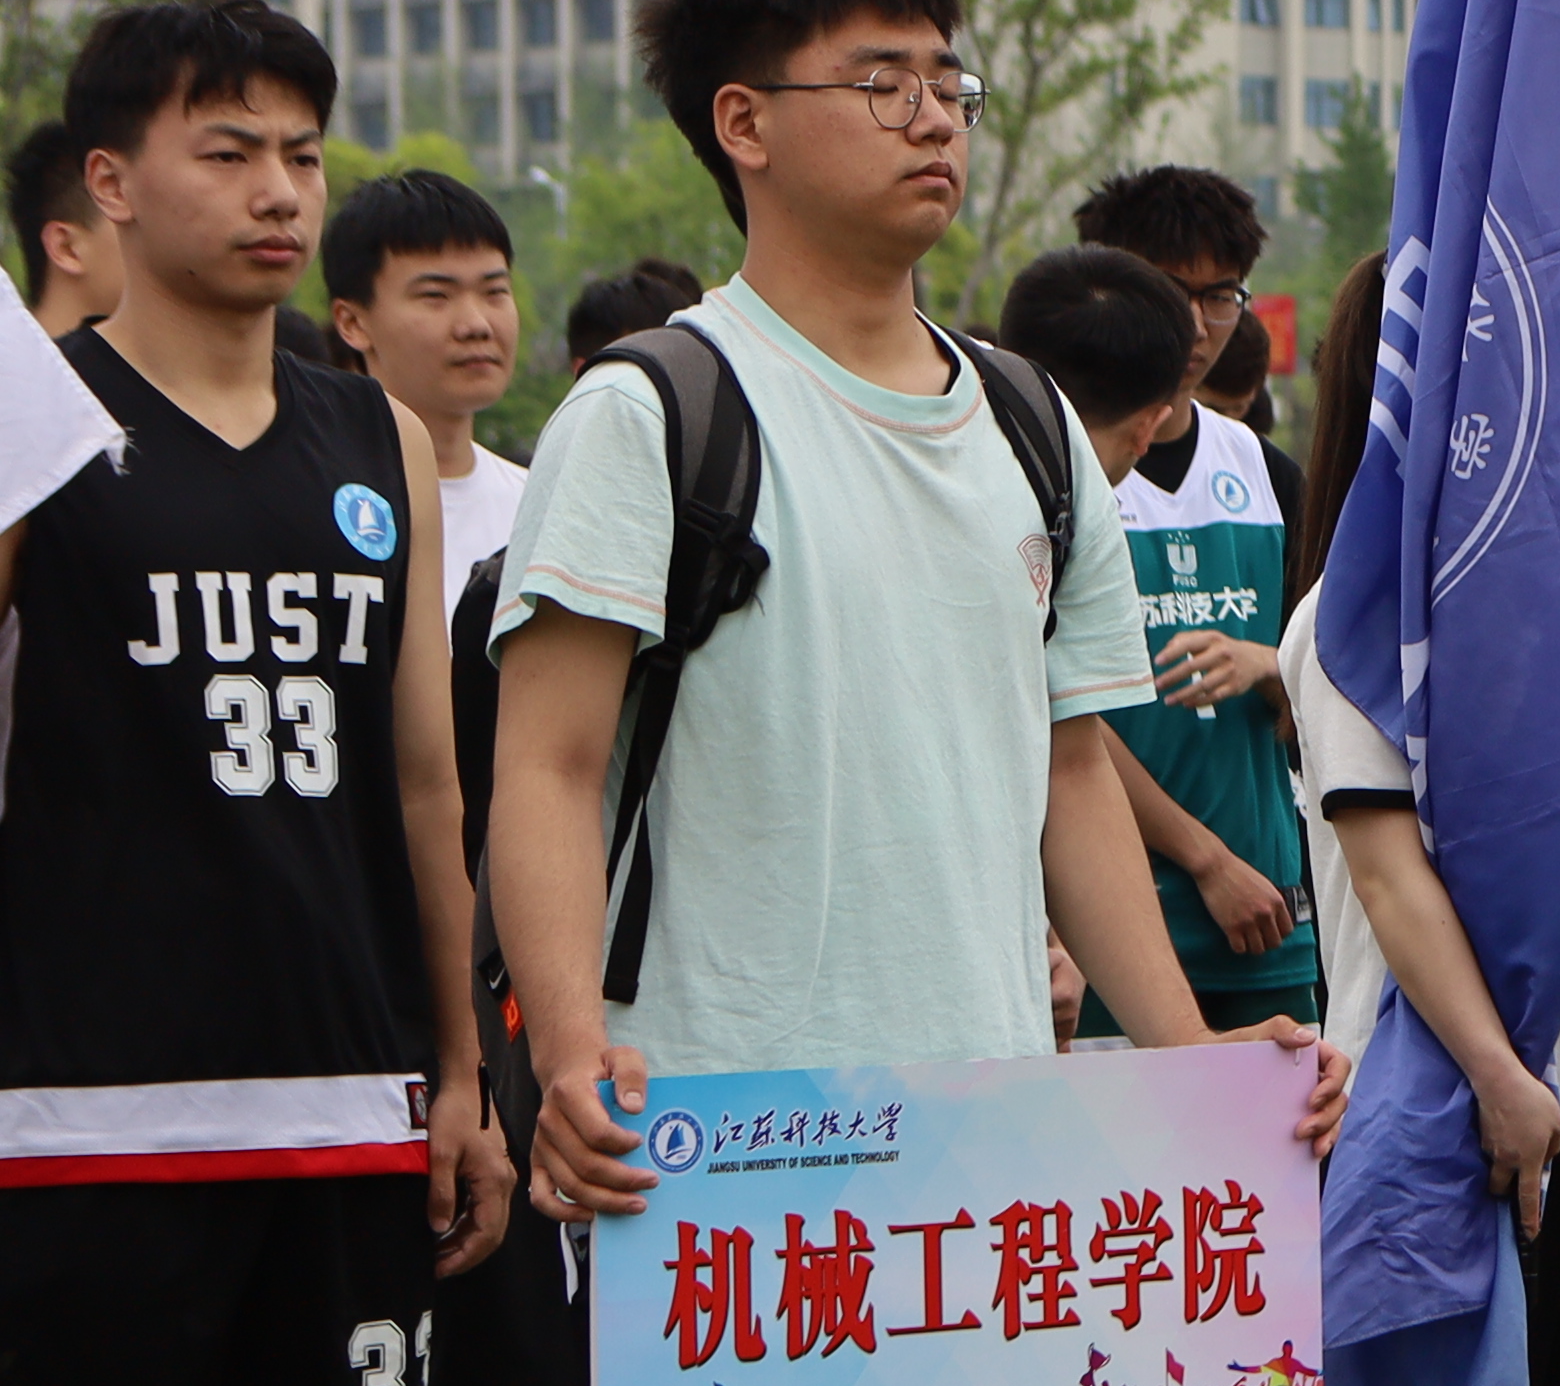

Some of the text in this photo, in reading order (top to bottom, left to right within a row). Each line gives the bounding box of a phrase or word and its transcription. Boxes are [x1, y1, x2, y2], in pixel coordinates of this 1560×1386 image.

[127, 571, 384, 666] JUST
[204, 674, 339, 797] 33
[707, 1149, 900, 1175] JIANGSU UNIVERSITY OF SCIENCE AND TECHNOLOGY
[663, 1179, 1267, 1370] 机械工程学院
